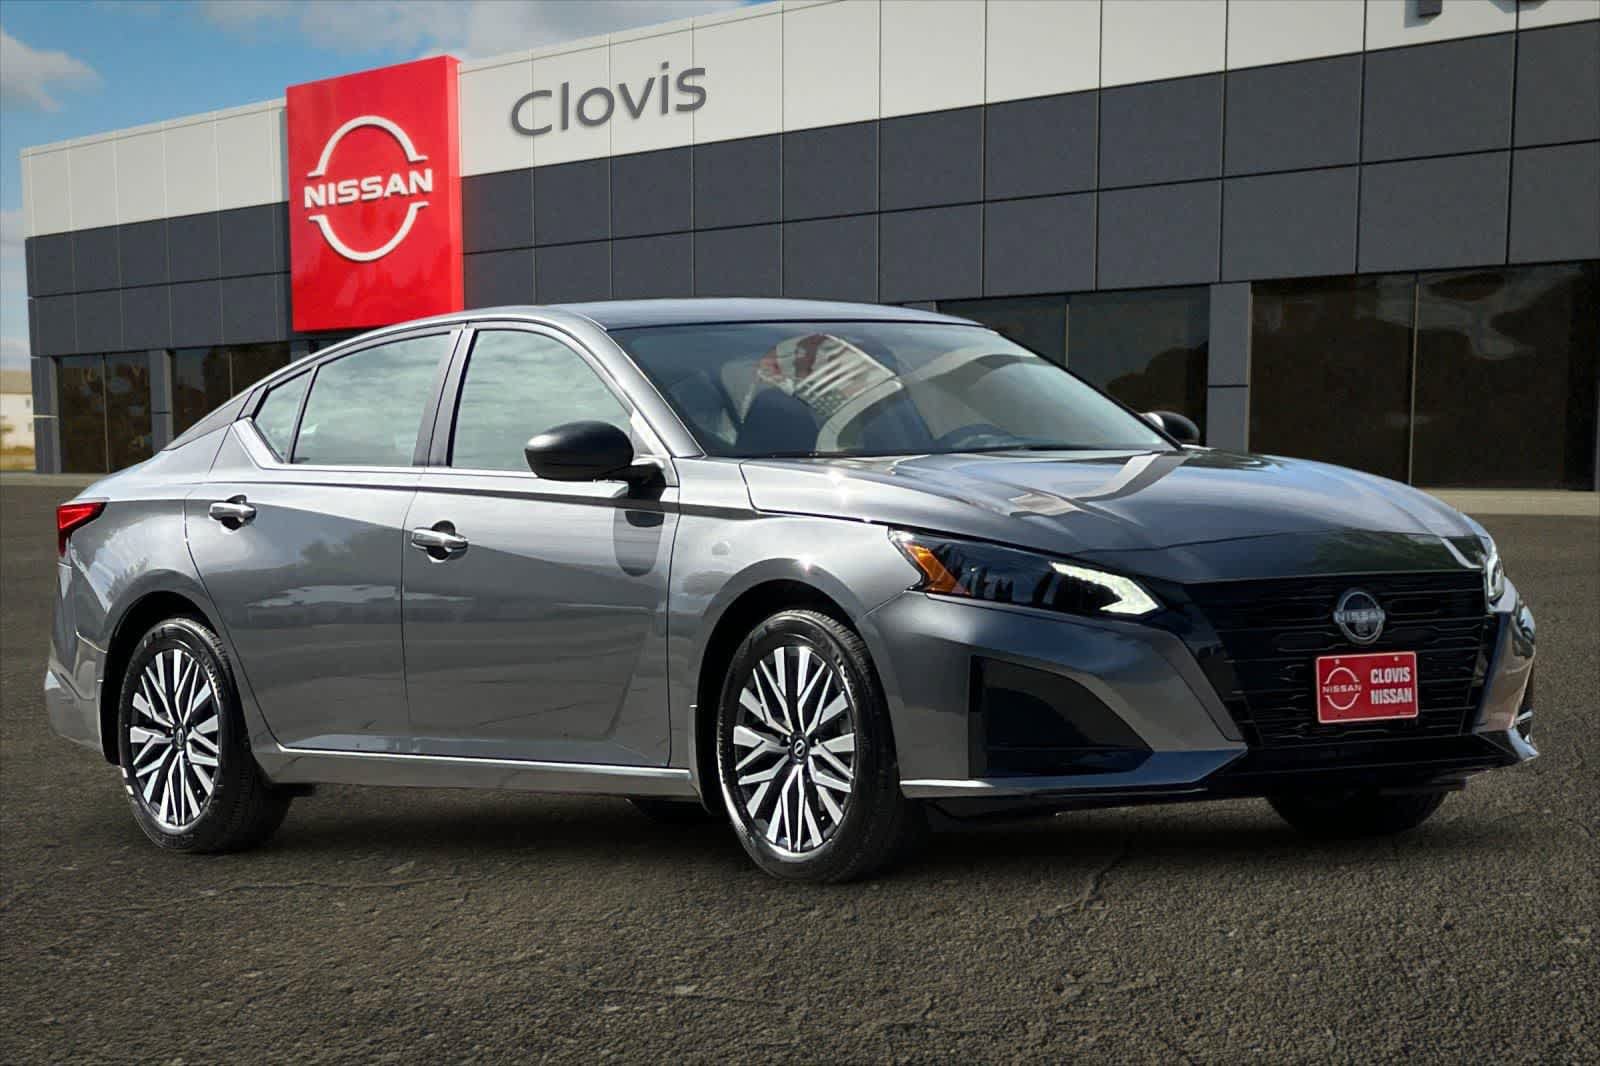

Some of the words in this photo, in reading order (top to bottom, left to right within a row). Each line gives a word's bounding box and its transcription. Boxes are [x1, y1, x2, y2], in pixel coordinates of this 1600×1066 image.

[511, 62, 706, 136] Clovis
[304, 169, 432, 208] NISSAN
[1334, 611, 1386, 623] NISSAN
[1370, 667, 1410, 684] CLOVIS
[1322, 684, 1362, 693] NISSAN
[1370, 688, 1412, 704] NISSAN
